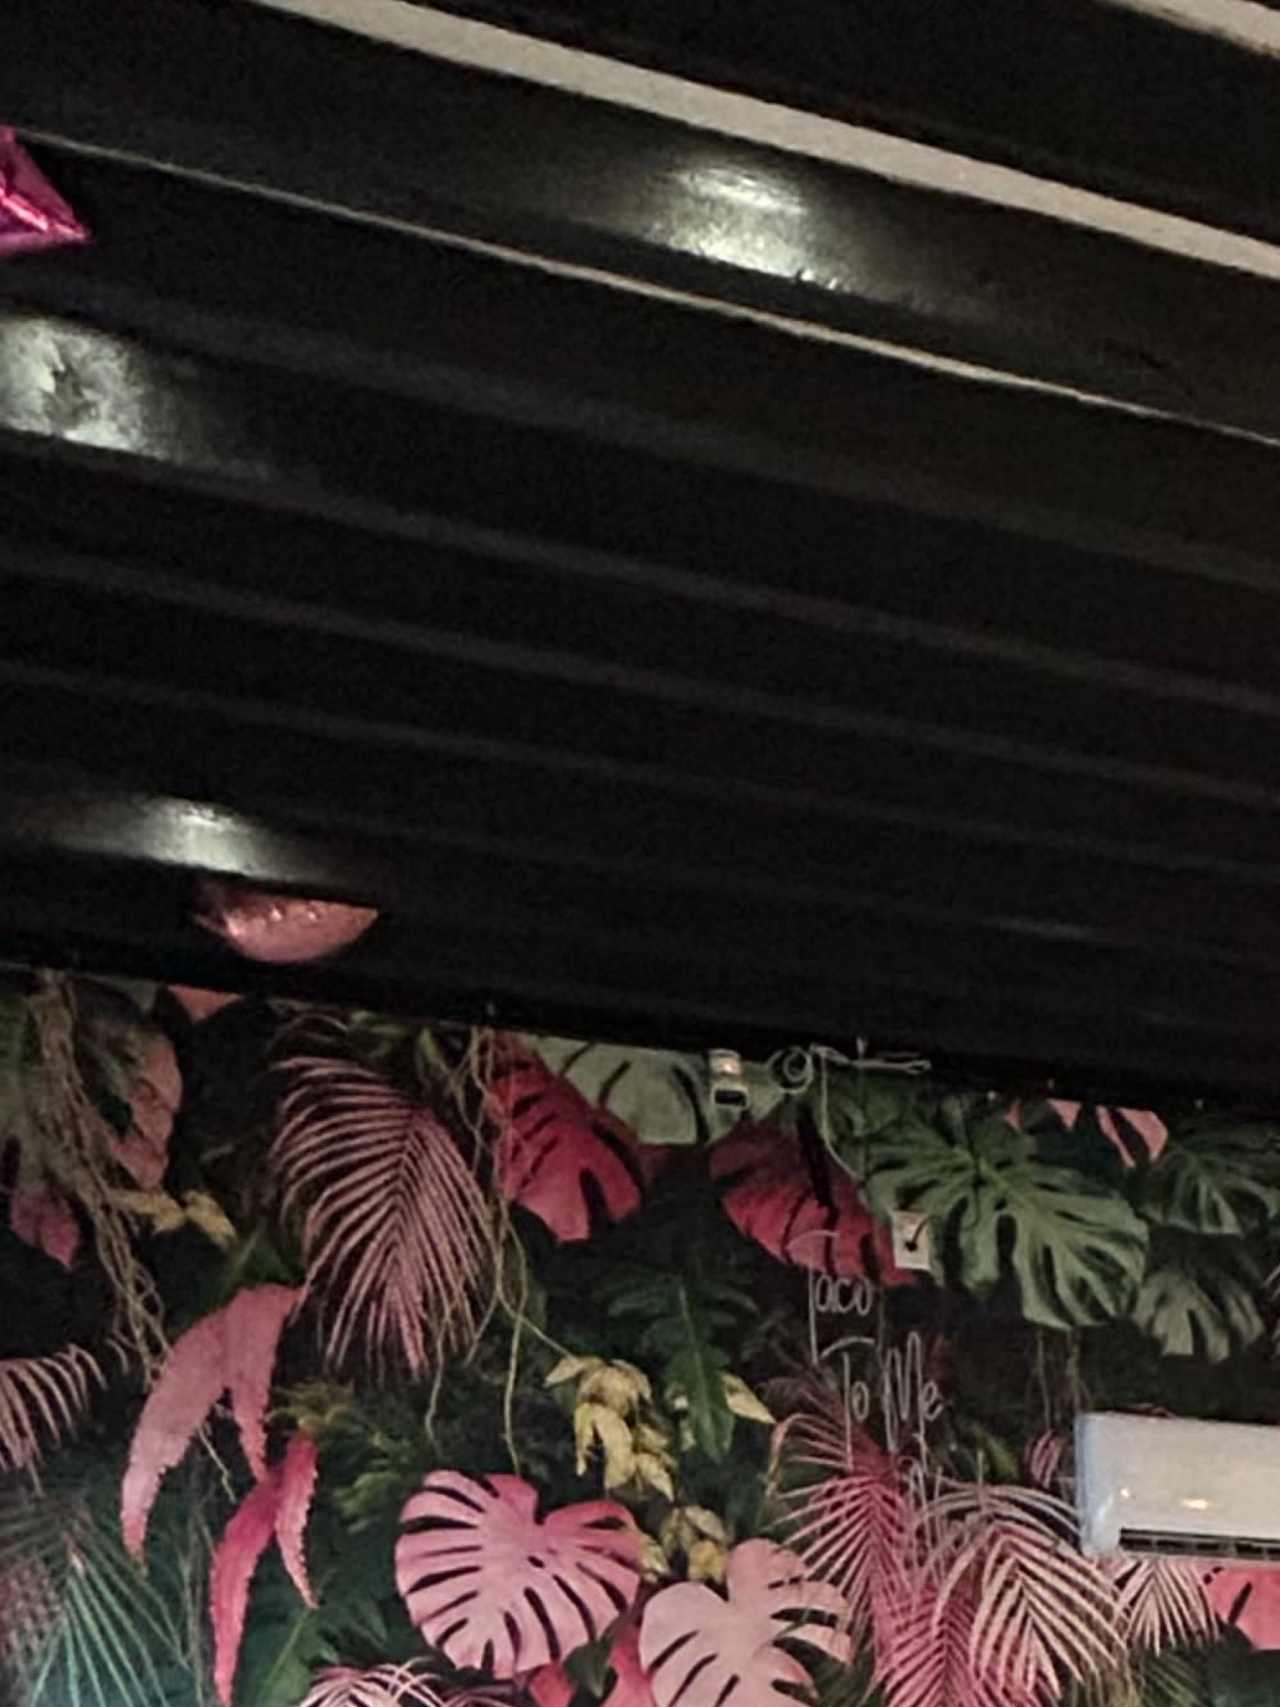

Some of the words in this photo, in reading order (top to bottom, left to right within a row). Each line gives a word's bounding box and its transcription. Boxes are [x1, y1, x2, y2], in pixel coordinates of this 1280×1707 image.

[784, 1229, 876, 1367] Taco
[820, 1335, 875, 1470] To
[879, 1331, 945, 1472] Me
